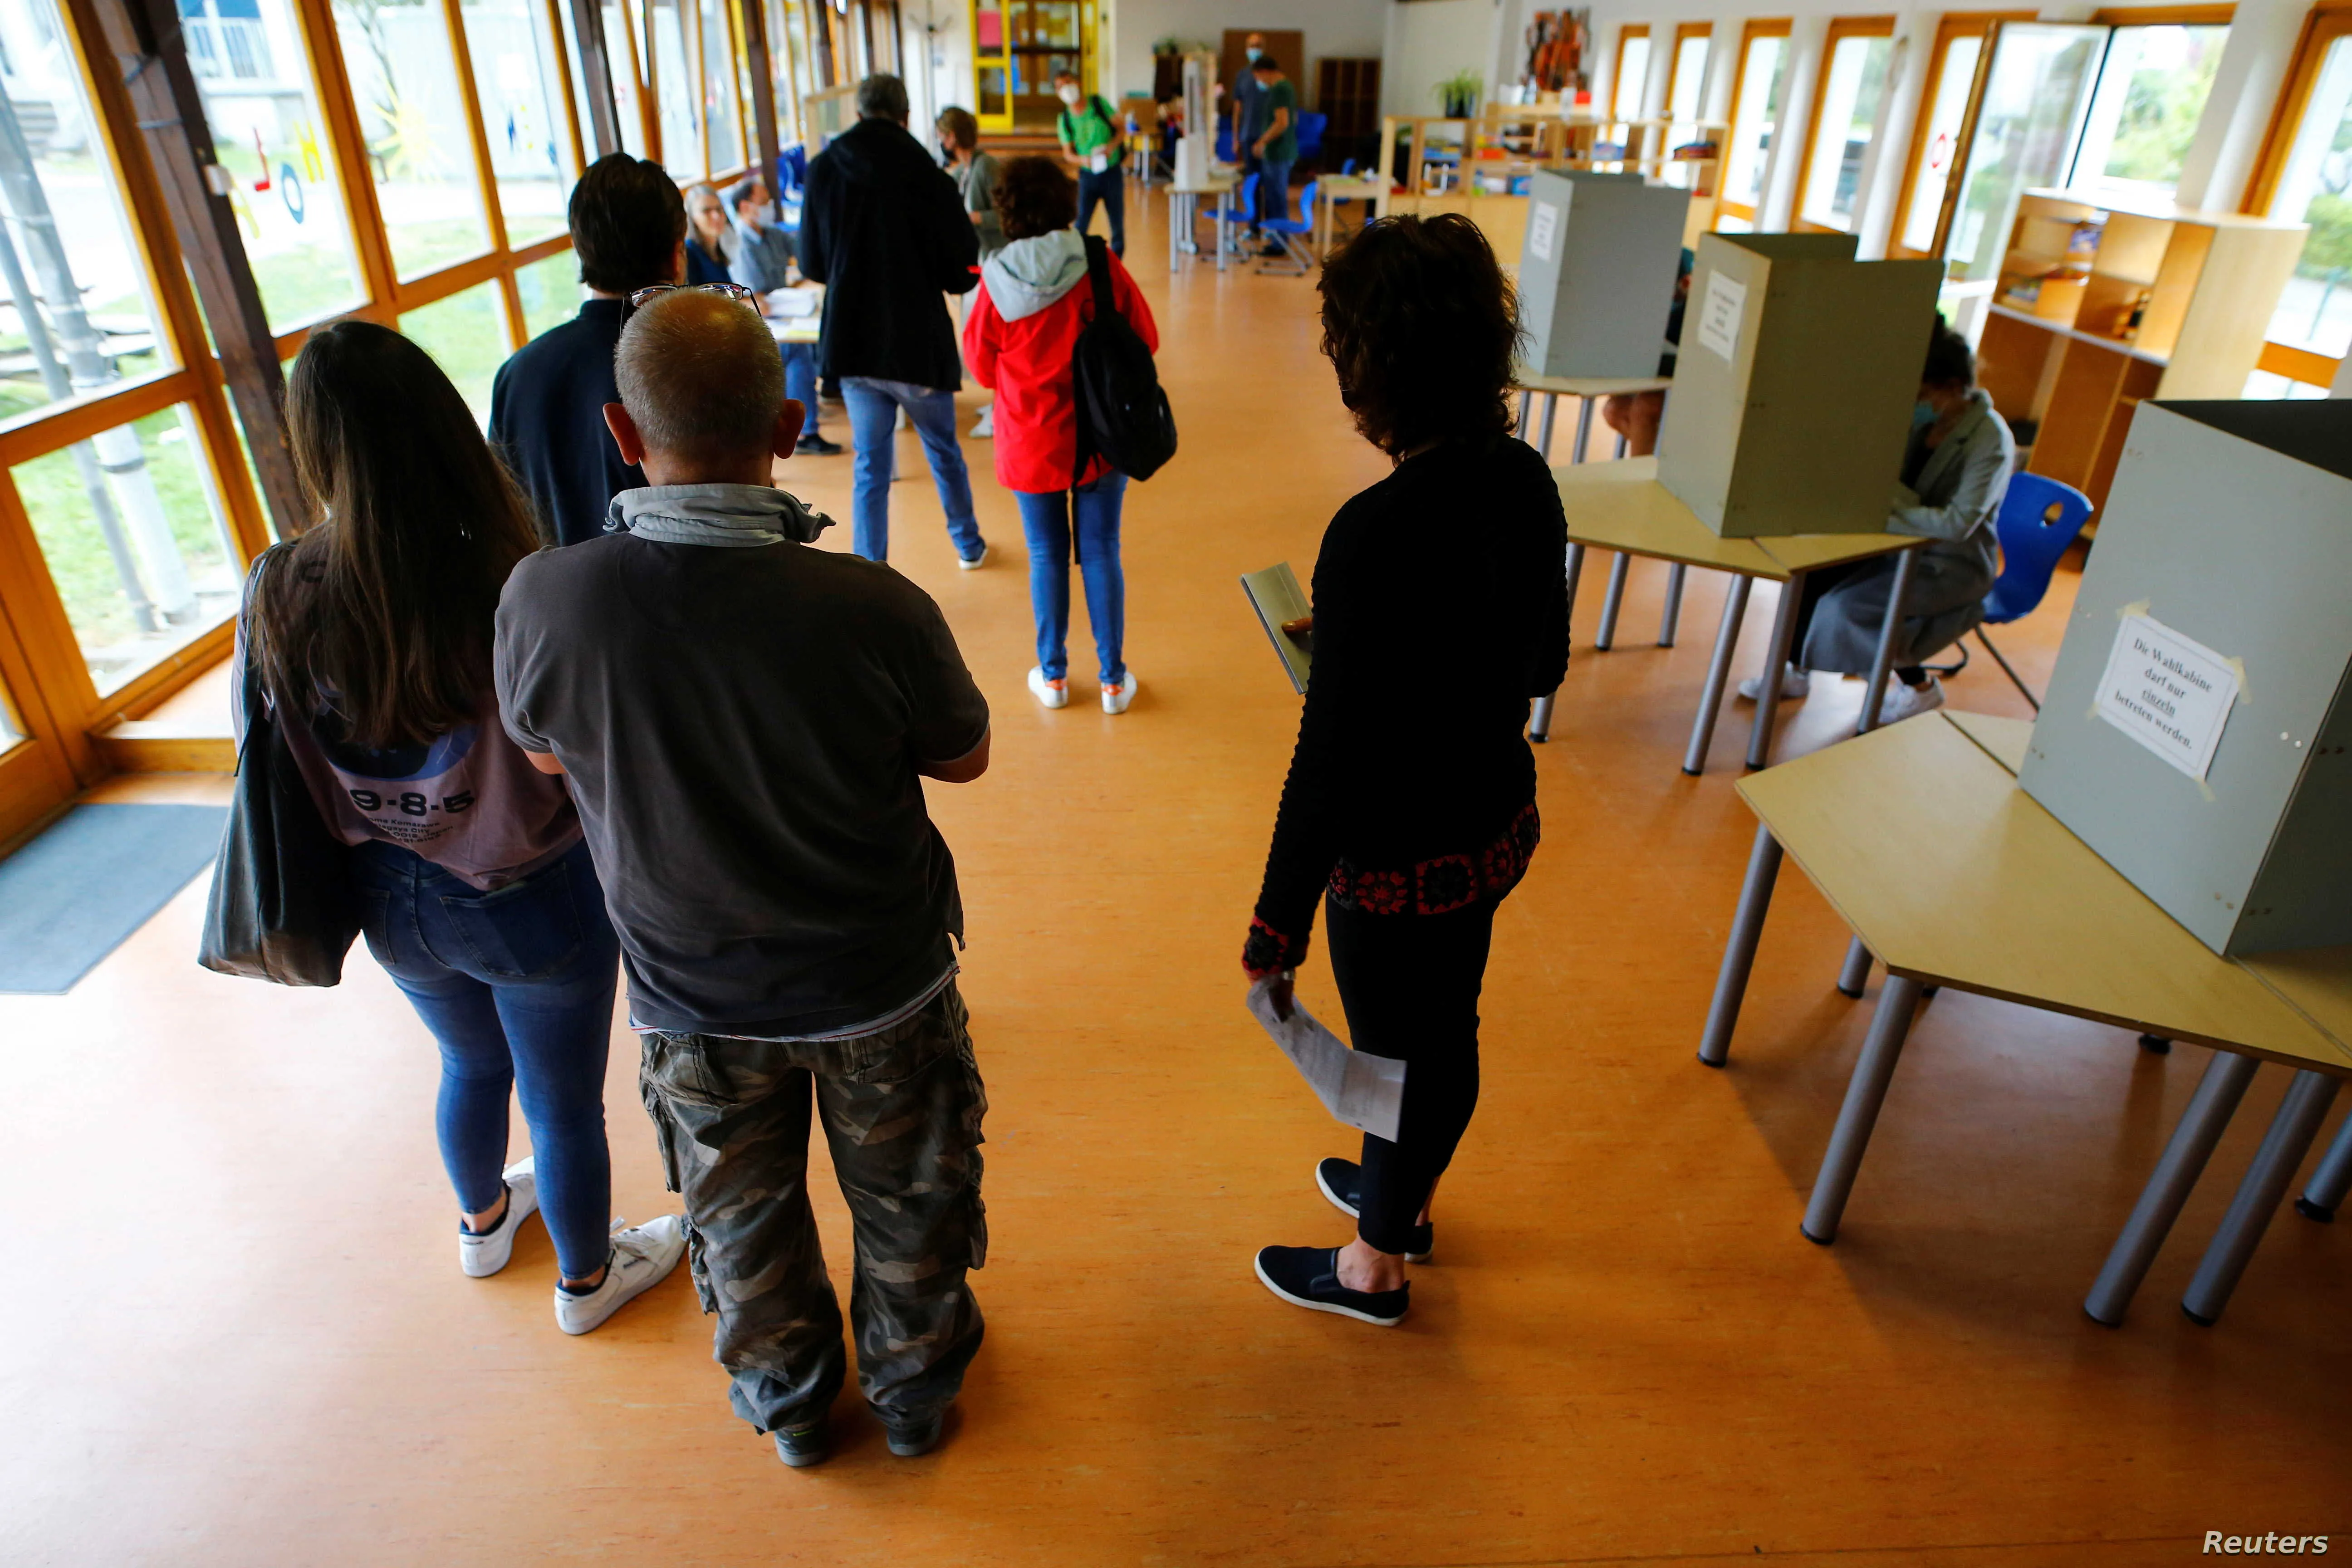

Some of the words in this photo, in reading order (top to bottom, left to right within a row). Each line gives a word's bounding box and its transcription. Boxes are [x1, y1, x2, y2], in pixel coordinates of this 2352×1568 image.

[2134, 637, 2149, 655] Die
[2152, 647, 2213, 692] Wahlkabine
[2145, 667, 2166, 687] darf
[2167, 681, 2187, 699] nur
[2114, 689, 2153, 722] betreten
[2155, 718, 2193, 750] werden.
[2141, 688, 2176, 716] einzeln
